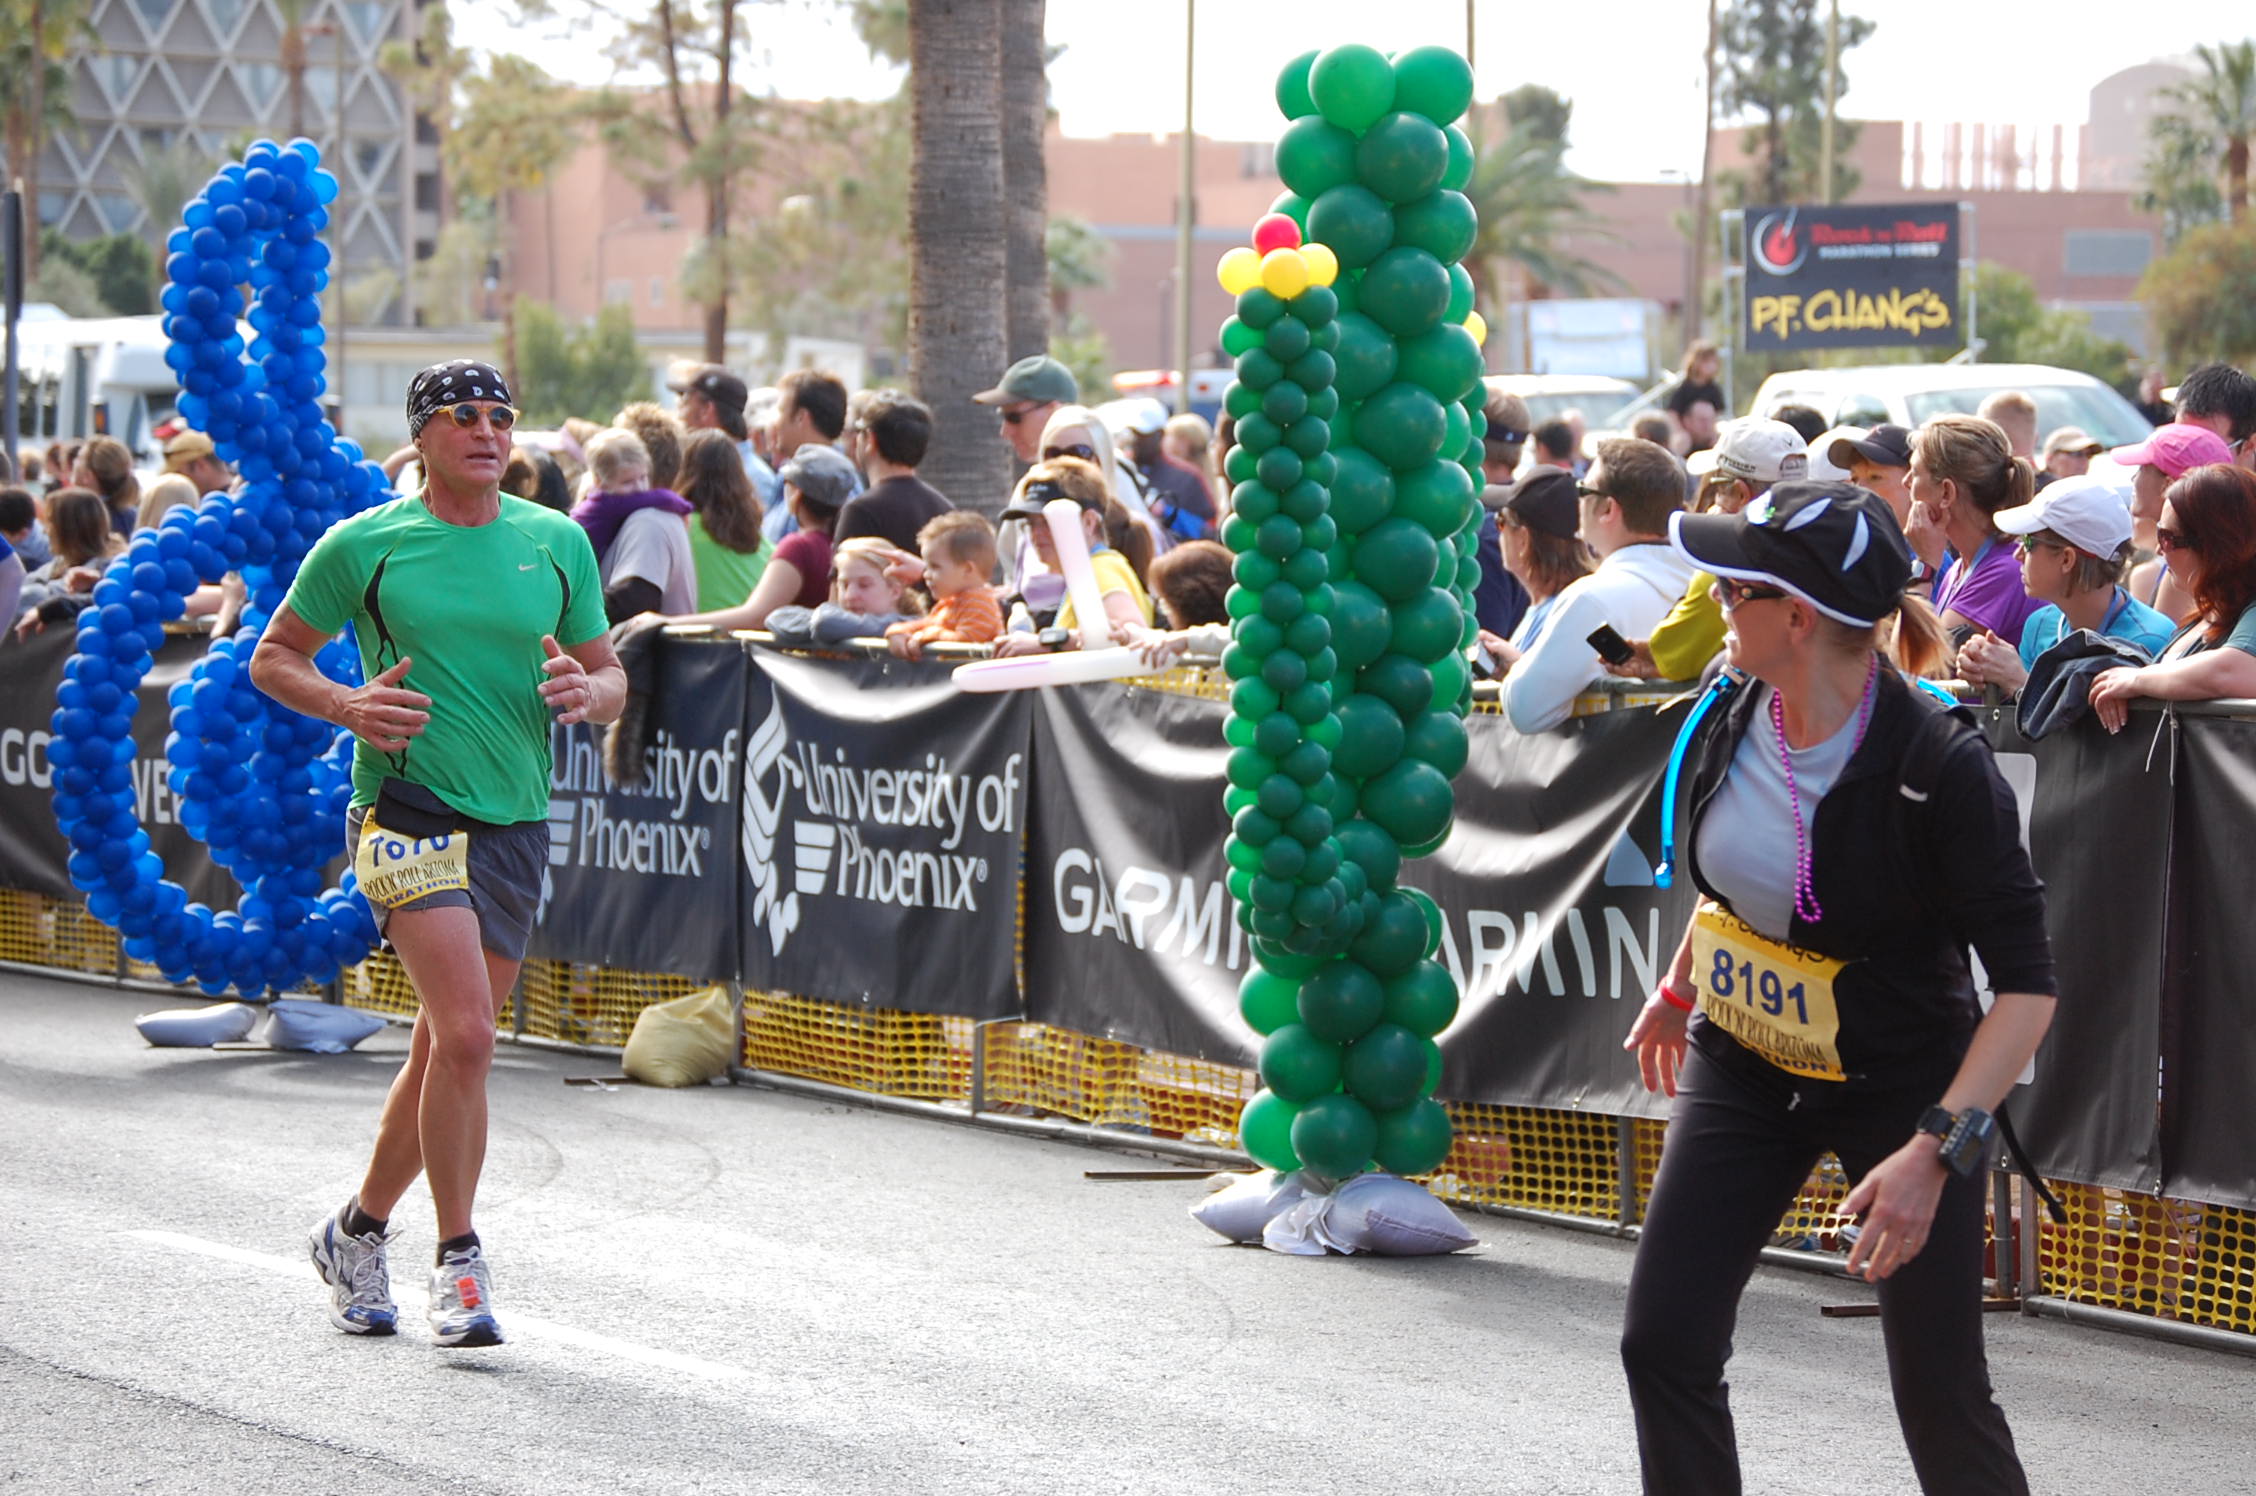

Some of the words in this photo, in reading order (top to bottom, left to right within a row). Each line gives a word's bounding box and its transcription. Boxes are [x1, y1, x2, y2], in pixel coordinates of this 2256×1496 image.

[698, 729, 738, 803] of
[797, 740, 970, 850] University
[976, 753, 1022, 833] of
[578, 797, 702, 878] Phoenix
[836, 823, 977, 912] Phoenix
[1053, 847, 1242, 971] GARMI
[1710, 949, 1809, 1025] 8191
